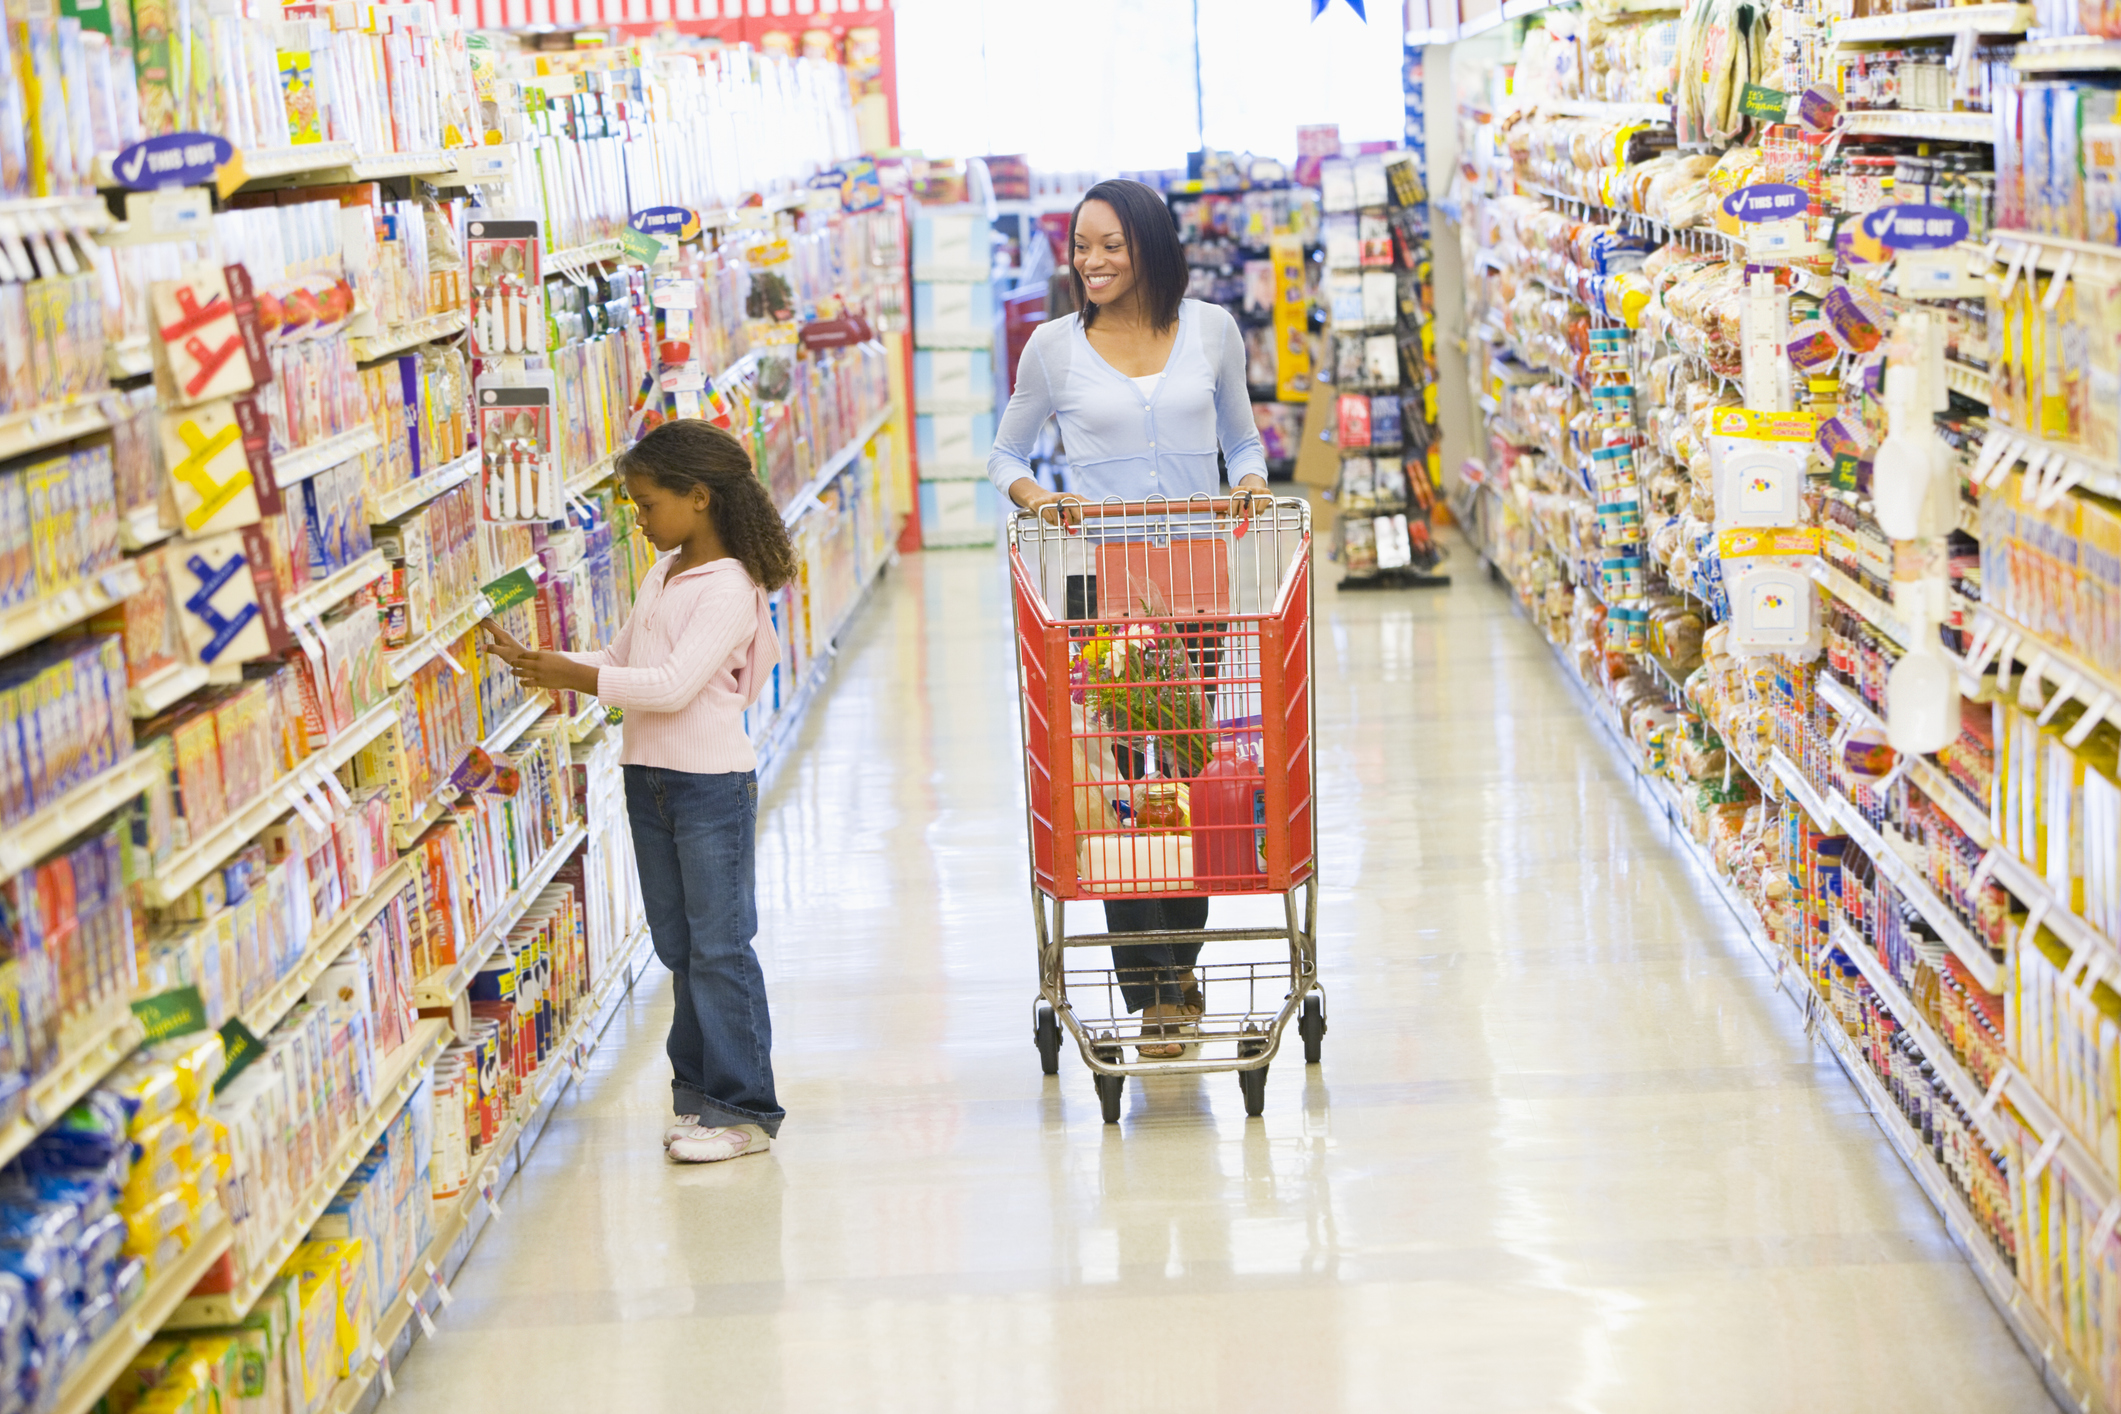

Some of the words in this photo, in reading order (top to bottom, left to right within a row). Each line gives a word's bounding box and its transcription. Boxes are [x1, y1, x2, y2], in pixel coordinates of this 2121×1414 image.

[1747, 90, 1764, 101] It's
[1746, 100, 1782, 115] Organic
[147, 148, 184, 174] THIS
[184, 141, 216, 168] OUT
[1749, 195, 1773, 209] THIS
[1774, 193, 1796, 207] OUT
[647, 214, 666, 226] THIS
[666, 212, 683, 224] OUT
[1894, 219, 1924, 236] THIS
[1926, 219, 1955, 236] OUT
[1773, 421, 1811, 429] SANDWICH
[1771, 429, 1812, 437] CONTAINER
[494, 585, 524, 611] rganic
